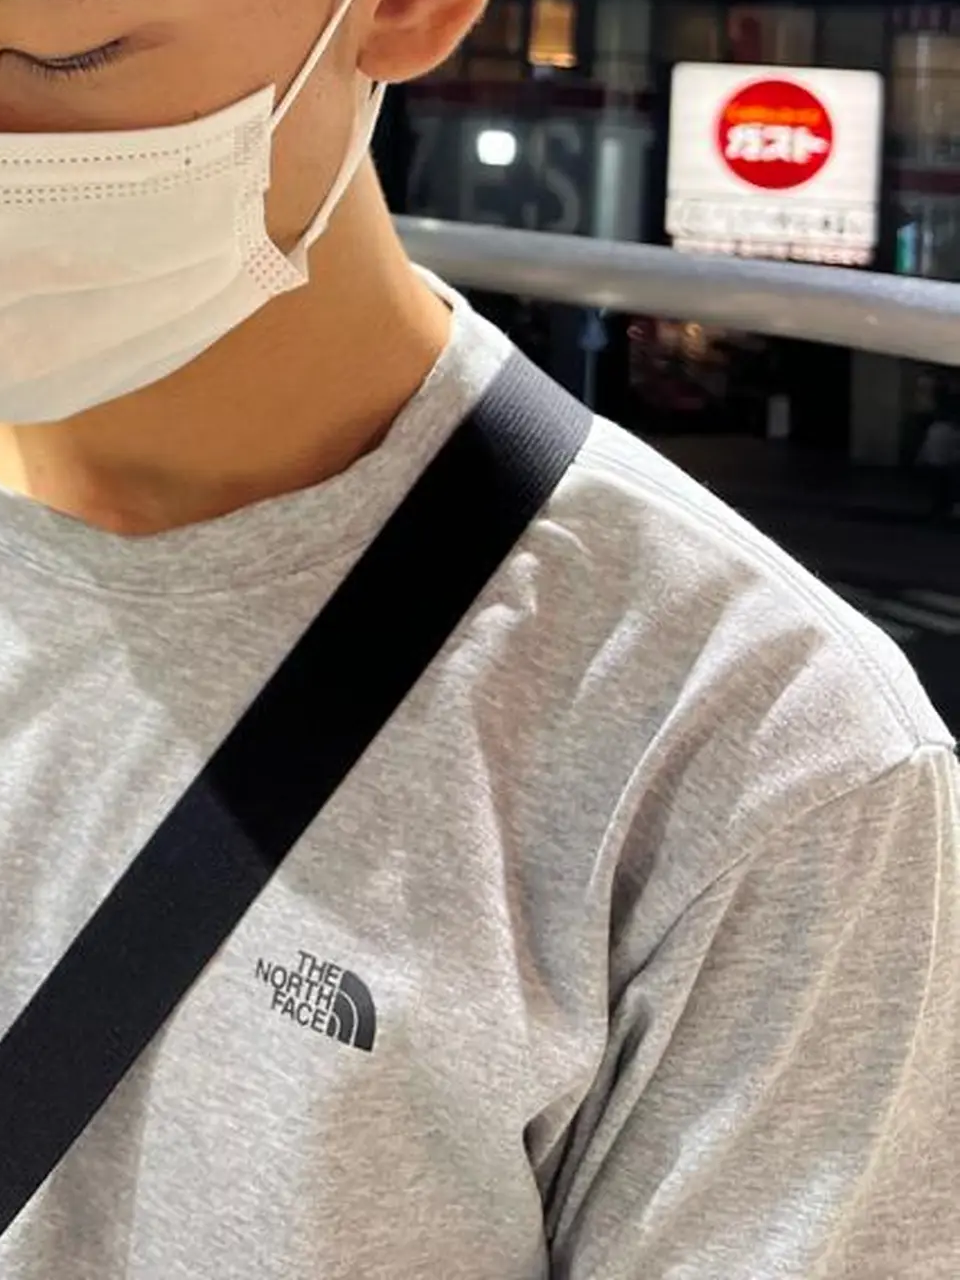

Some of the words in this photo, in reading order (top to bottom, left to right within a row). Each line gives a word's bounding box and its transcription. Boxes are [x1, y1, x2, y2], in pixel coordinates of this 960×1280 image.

[254, 957, 335, 1010] NORTH
[298, 949, 342, 987] THE
[270, 989, 328, 1033] FACE
